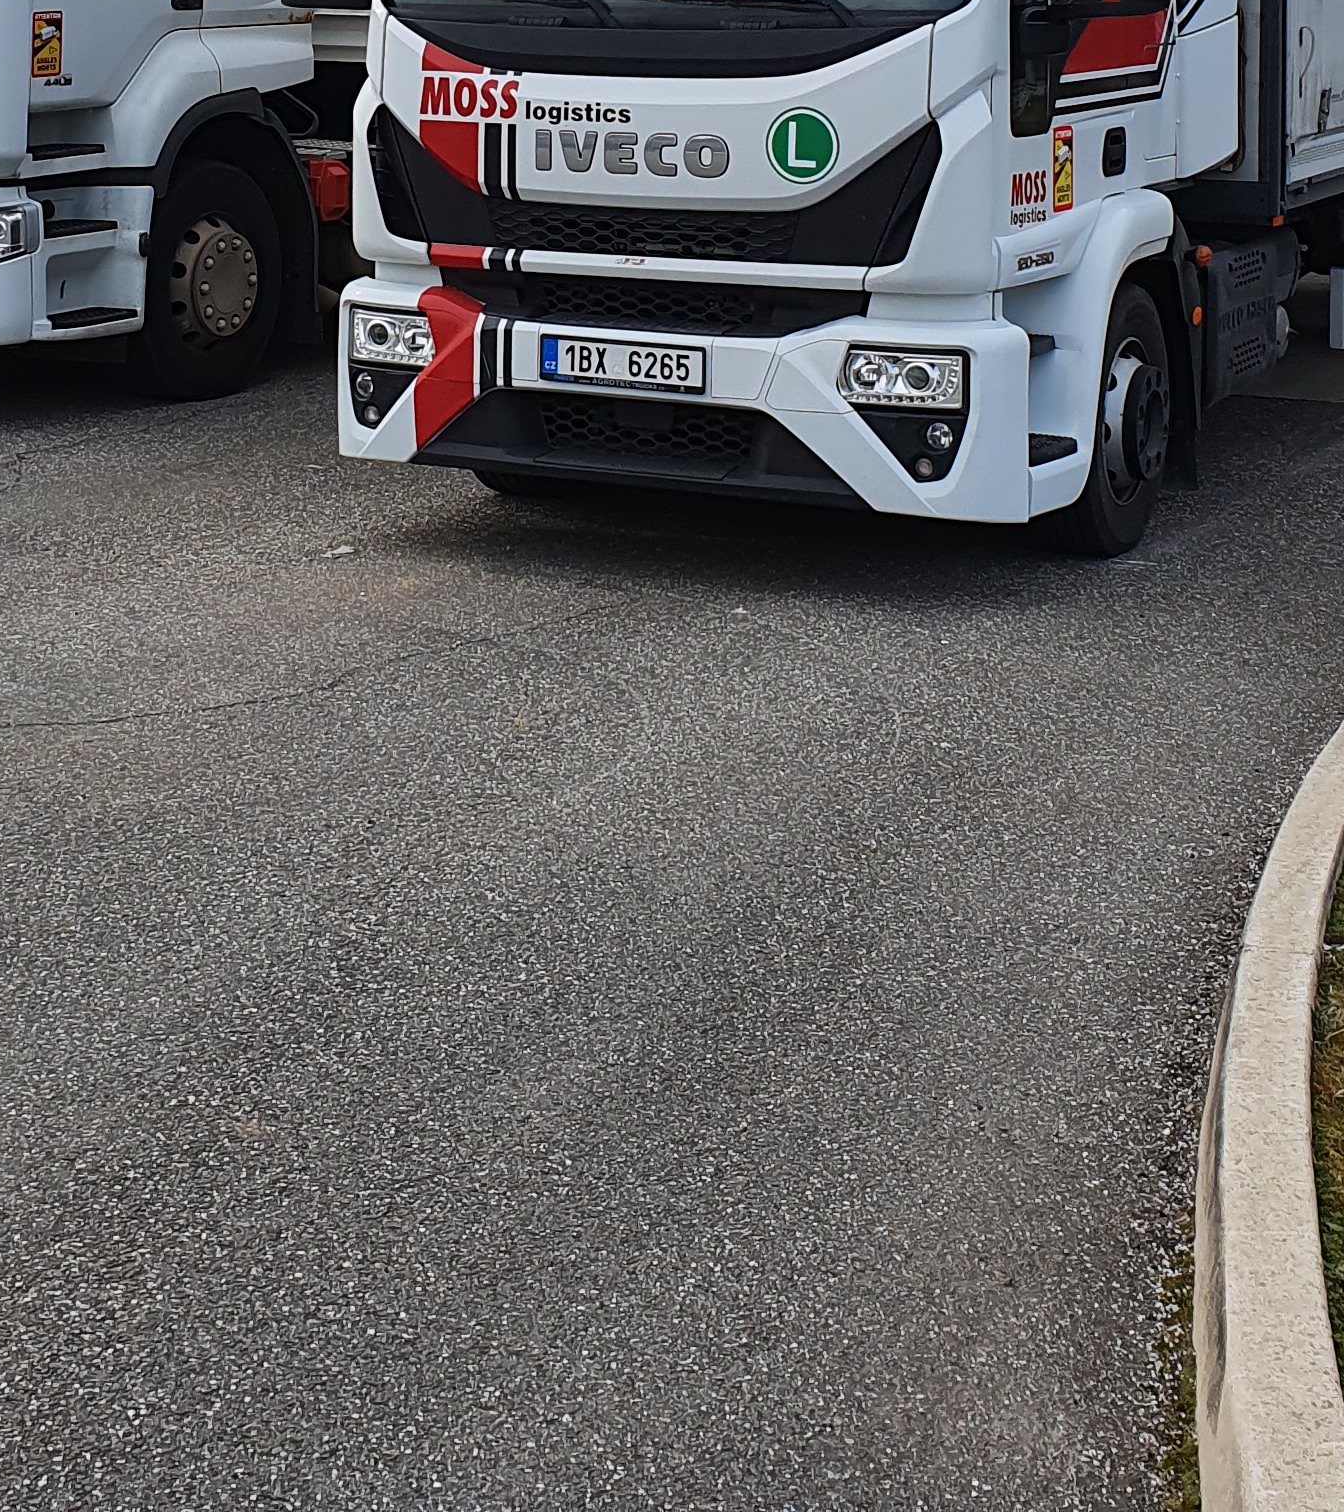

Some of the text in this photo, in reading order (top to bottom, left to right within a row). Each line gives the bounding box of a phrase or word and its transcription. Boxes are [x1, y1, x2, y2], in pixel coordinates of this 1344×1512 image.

[420, 76, 632, 125] MOSS logistics
[534, 128, 730, 179] IVECO
[787, 120, 817, 169] L
[1011, 170, 1047, 207] MOSS
[1010, 206, 1047, 228] logistics
[544, 344, 690, 382] CZ 1BX 6265
